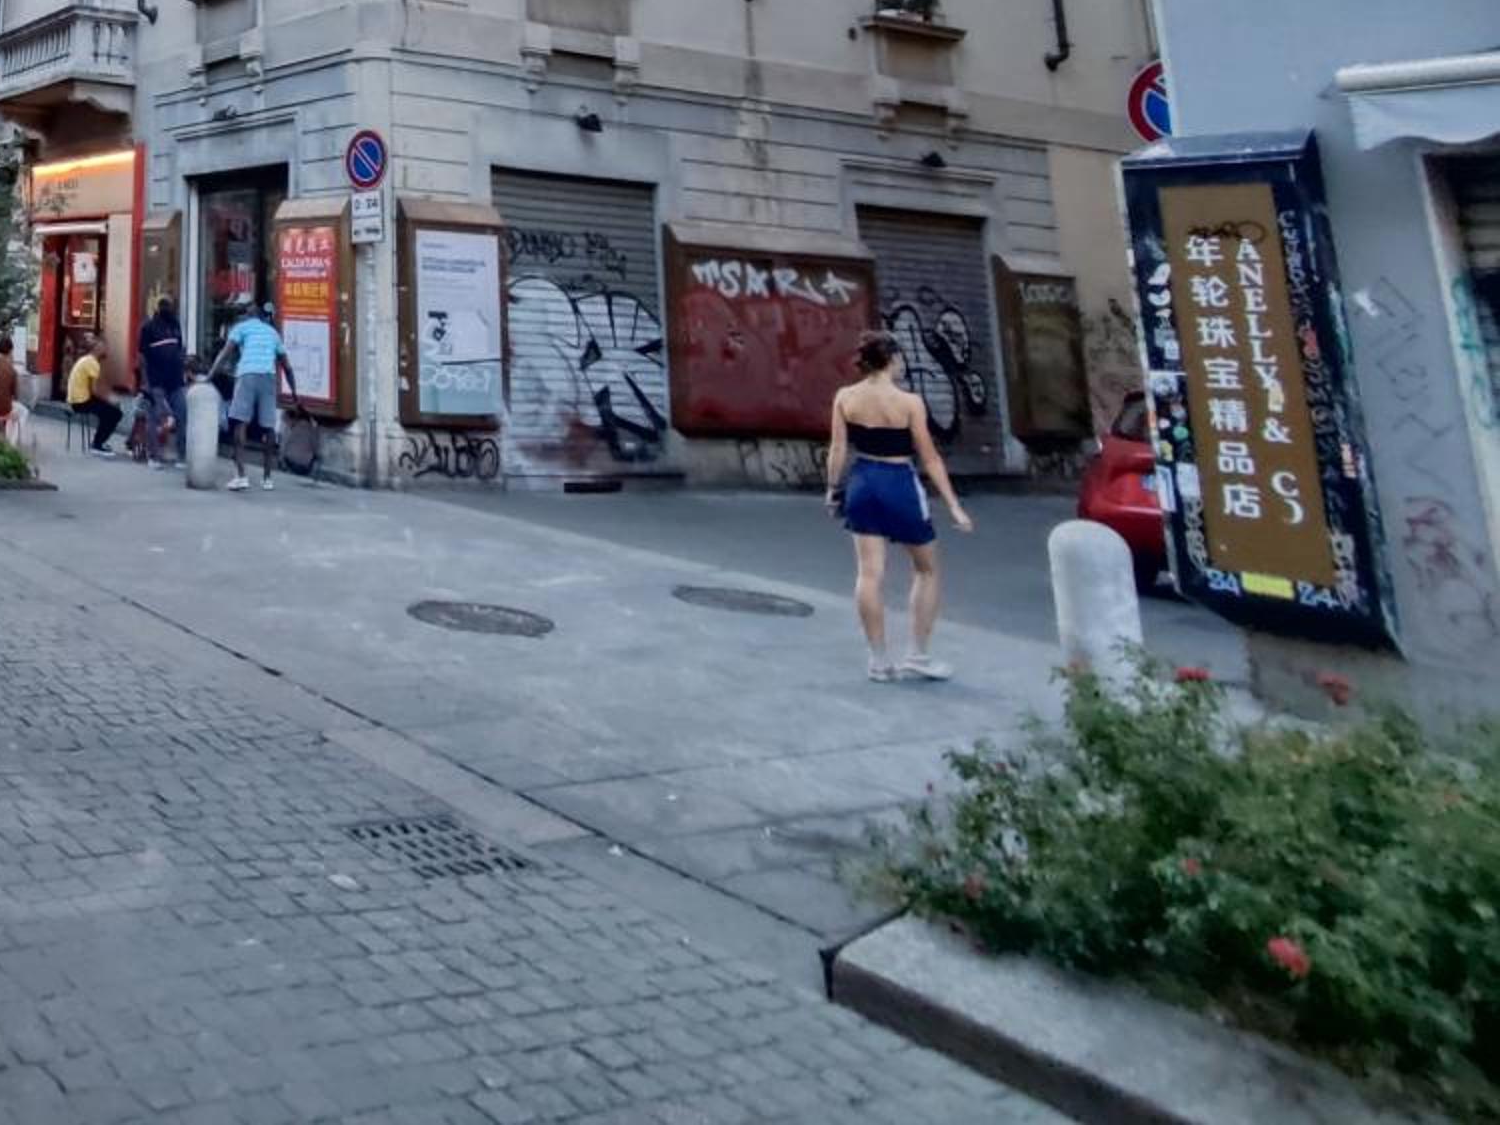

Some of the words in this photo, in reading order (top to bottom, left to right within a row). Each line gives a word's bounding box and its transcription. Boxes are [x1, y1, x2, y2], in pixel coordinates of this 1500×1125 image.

[1185, 235, 1262, 520] 年轮珠宝精品店
[1235, 239, 1284, 395] ANELLY
[1262, 418, 1292, 445] &
